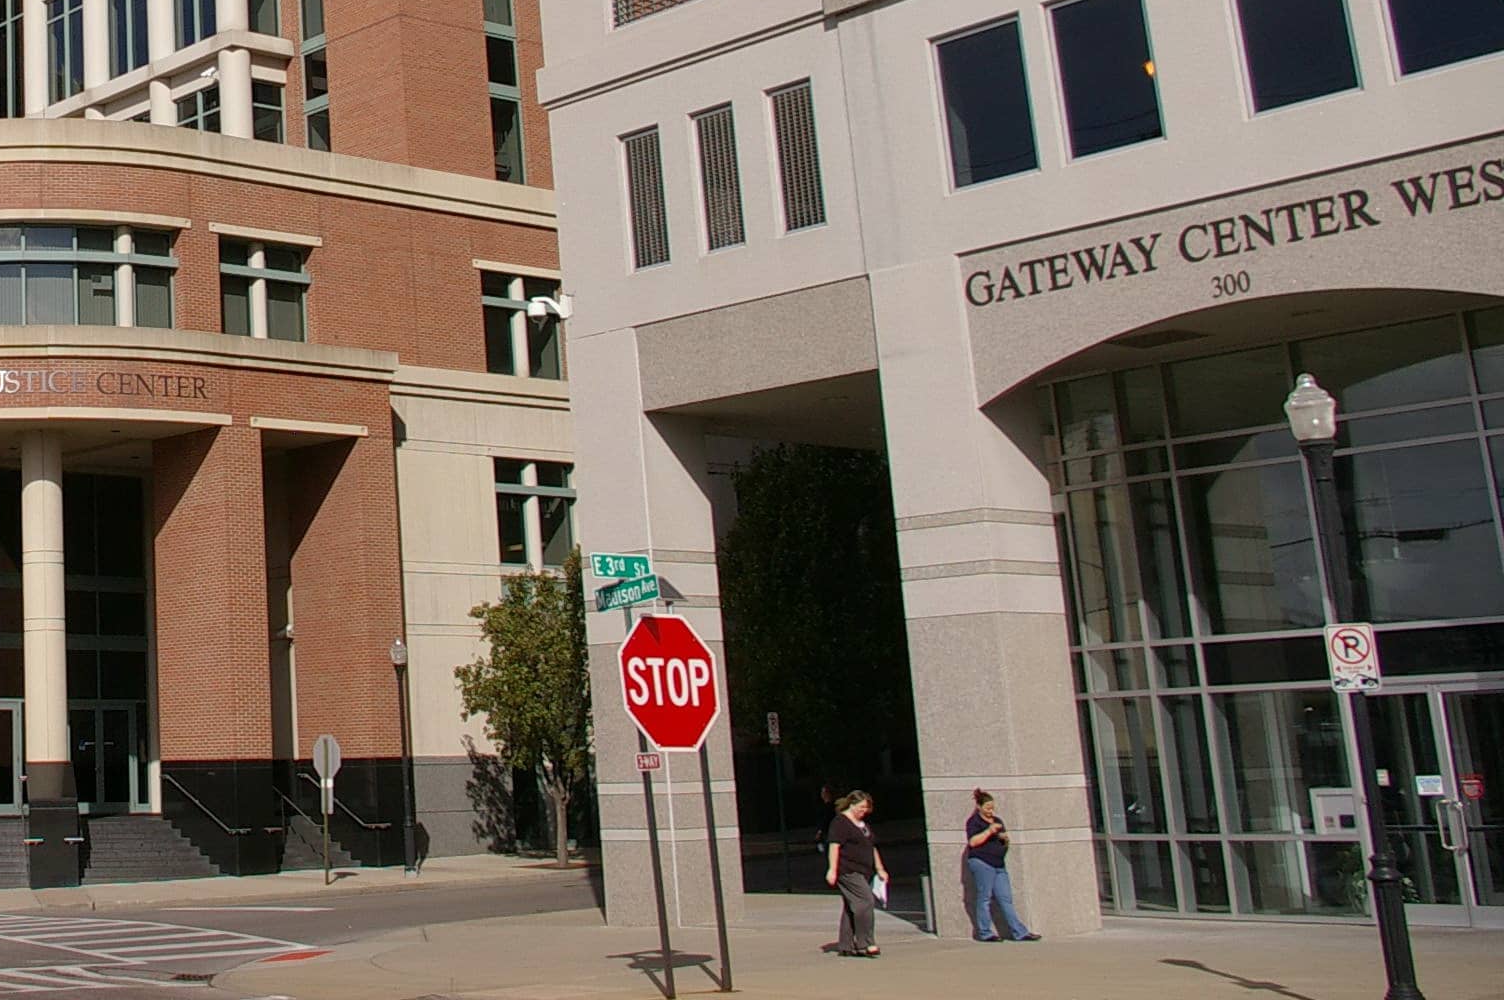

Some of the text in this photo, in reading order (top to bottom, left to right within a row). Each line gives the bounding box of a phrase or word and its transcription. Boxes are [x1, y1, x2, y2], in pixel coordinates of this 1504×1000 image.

[965, 158, 1504, 307] GATEWAY CENTER WES
[1211, 271, 1251, 298] 300
[96, 371, 208, 400] CENTER
[594, 556, 646, 577] E 3rd St
[596, 585, 642, 609] Madison
[627, 656, 710, 707] STOP
